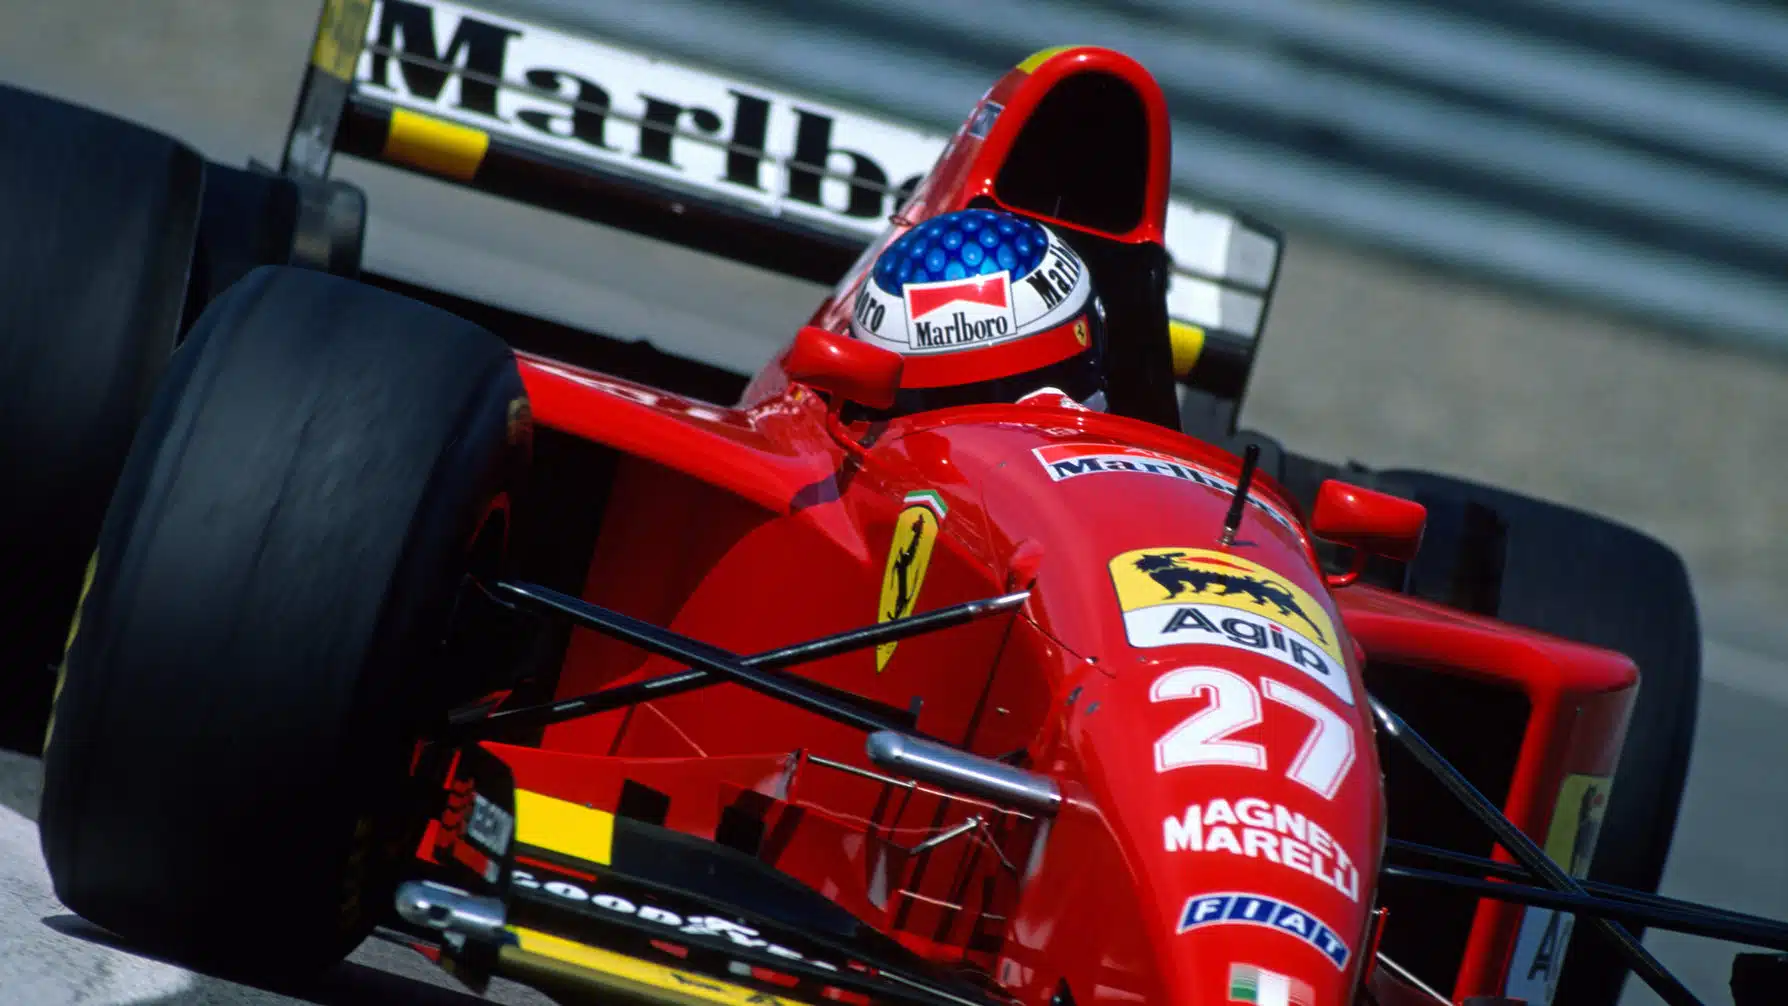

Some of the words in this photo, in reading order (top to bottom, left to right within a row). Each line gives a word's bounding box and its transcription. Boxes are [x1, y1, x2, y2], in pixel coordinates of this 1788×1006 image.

[371, 0, 927, 219] Marlb
[915, 312, 1008, 347] Marlboro
[1160, 607, 1330, 676] Agip
[1150, 665, 1356, 800] 27
[1162, 804, 1359, 902] MARELLI
[1193, 896, 1344, 961] FIAT
